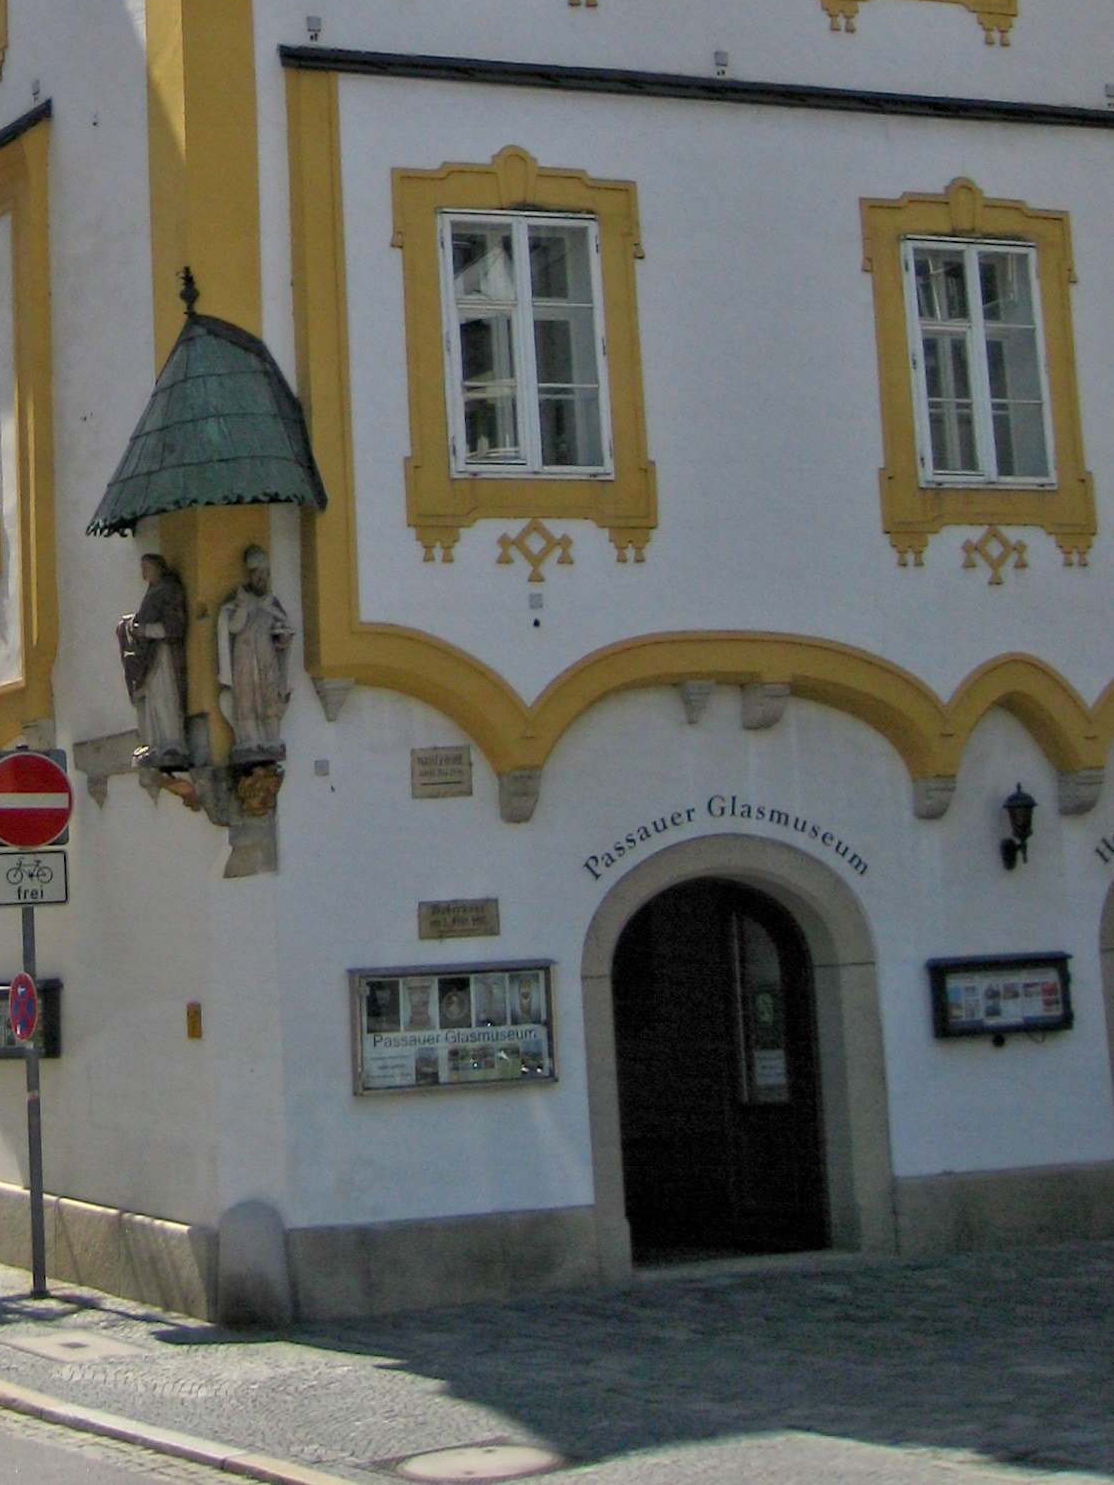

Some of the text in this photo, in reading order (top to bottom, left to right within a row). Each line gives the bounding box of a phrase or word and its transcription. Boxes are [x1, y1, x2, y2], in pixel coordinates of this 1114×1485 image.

[583, 794, 869, 881] Passauer Glasmuseum
[17, 885, 44, 900] frei
[373, 1027, 537, 1048] Passauer Glasmuseum
